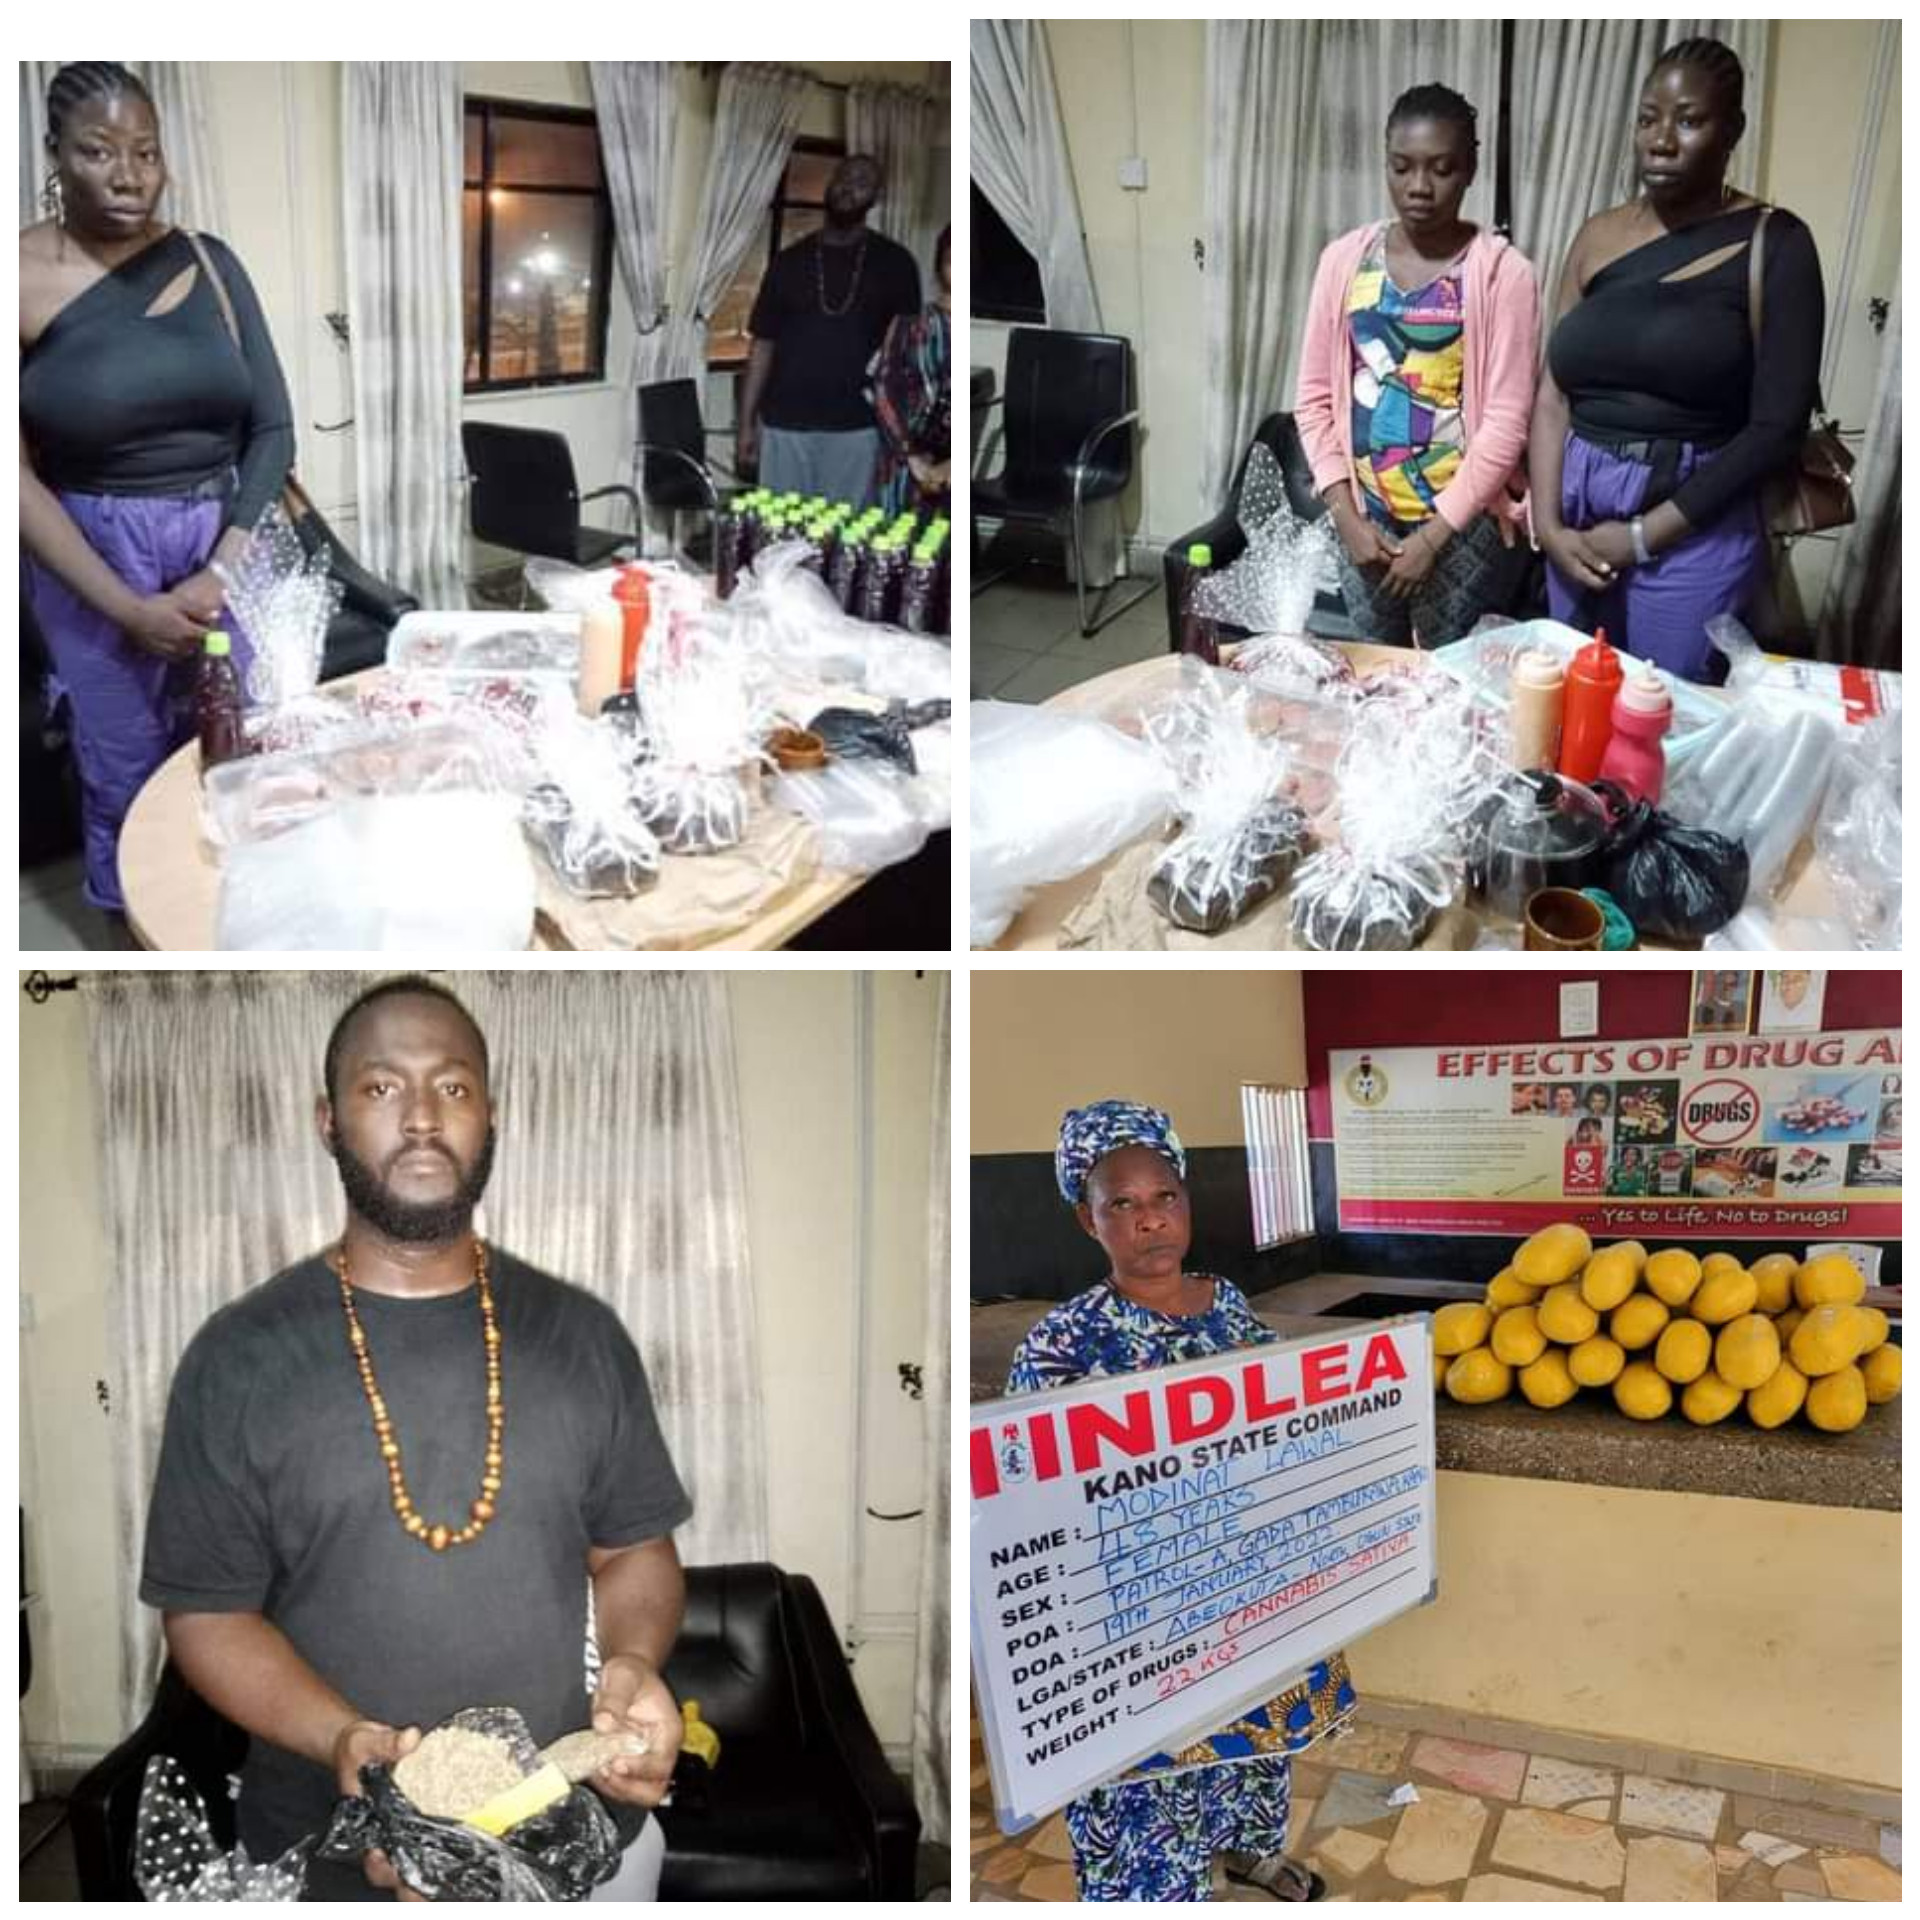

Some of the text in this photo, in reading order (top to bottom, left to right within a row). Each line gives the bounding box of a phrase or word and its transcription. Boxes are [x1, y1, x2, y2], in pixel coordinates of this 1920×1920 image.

[1436, 1036, 1902, 1077] EFFECTS OF DRUG A
[1689, 1101, 1751, 1123] DRUGS
[1602, 1208, 1634, 1225] Yes
[1640, 1209, 1659, 1222] to
[1716, 1208, 1743, 1223] No
[1749, 1209, 1769, 1222] to
[1775, 1208, 1848, 1228] Drugs!
[1083, 1387, 1402, 1503] KANO STATE COMMAND
[1097, 1428, 1353, 1526] MODINAT LAWAL
[1105, 1516, 1243, 1584] FEMALE
[1223, 1532, 1411, 1636] CANNABIS SATIVA
[1021, 1701, 1087, 1739] TYPE
[1092, 1680, 1121, 1704] OF
[1158, 1667, 1196, 1697] 22
